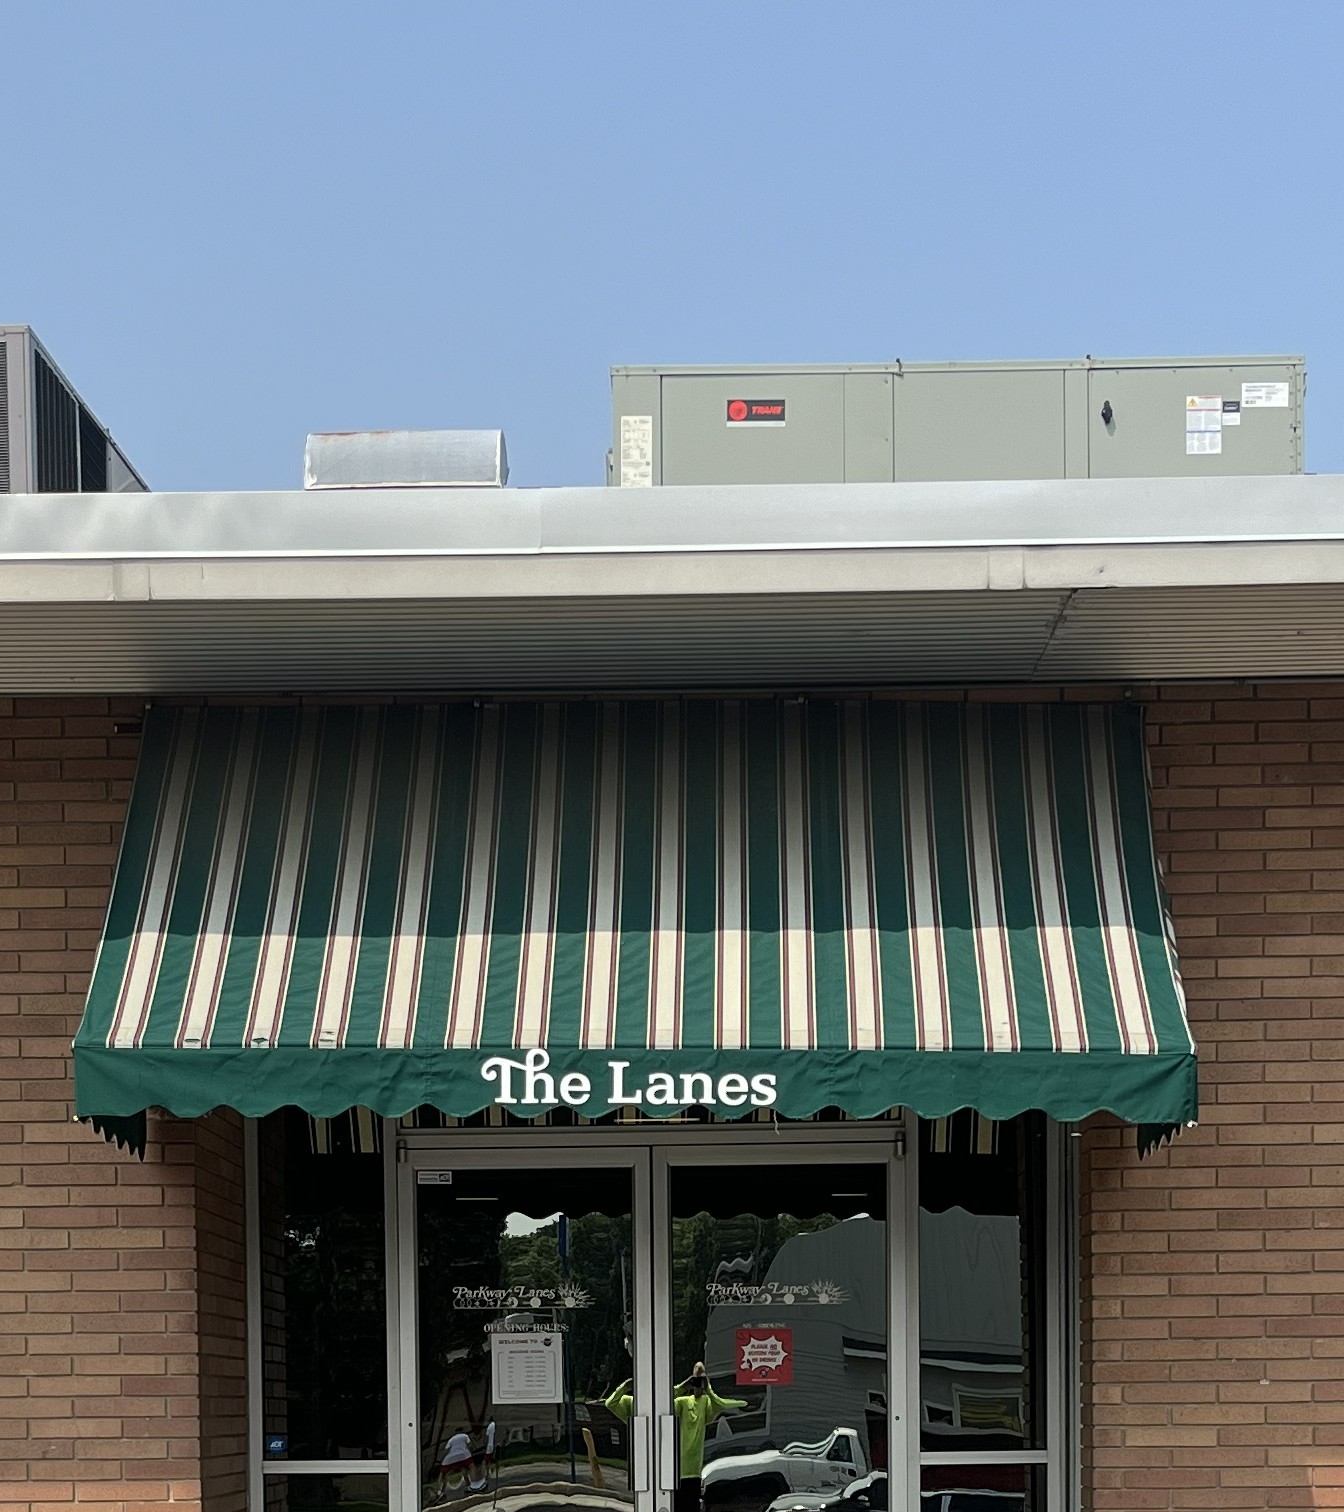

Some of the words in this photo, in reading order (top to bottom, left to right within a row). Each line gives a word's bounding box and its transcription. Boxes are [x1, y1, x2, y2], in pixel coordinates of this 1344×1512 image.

[481, 1048, 591, 1105] The
[607, 1061, 777, 1106] Lanes
[514, 1285, 556, 1299] Lanes
[768, 1282, 809, 1295] Lanes
